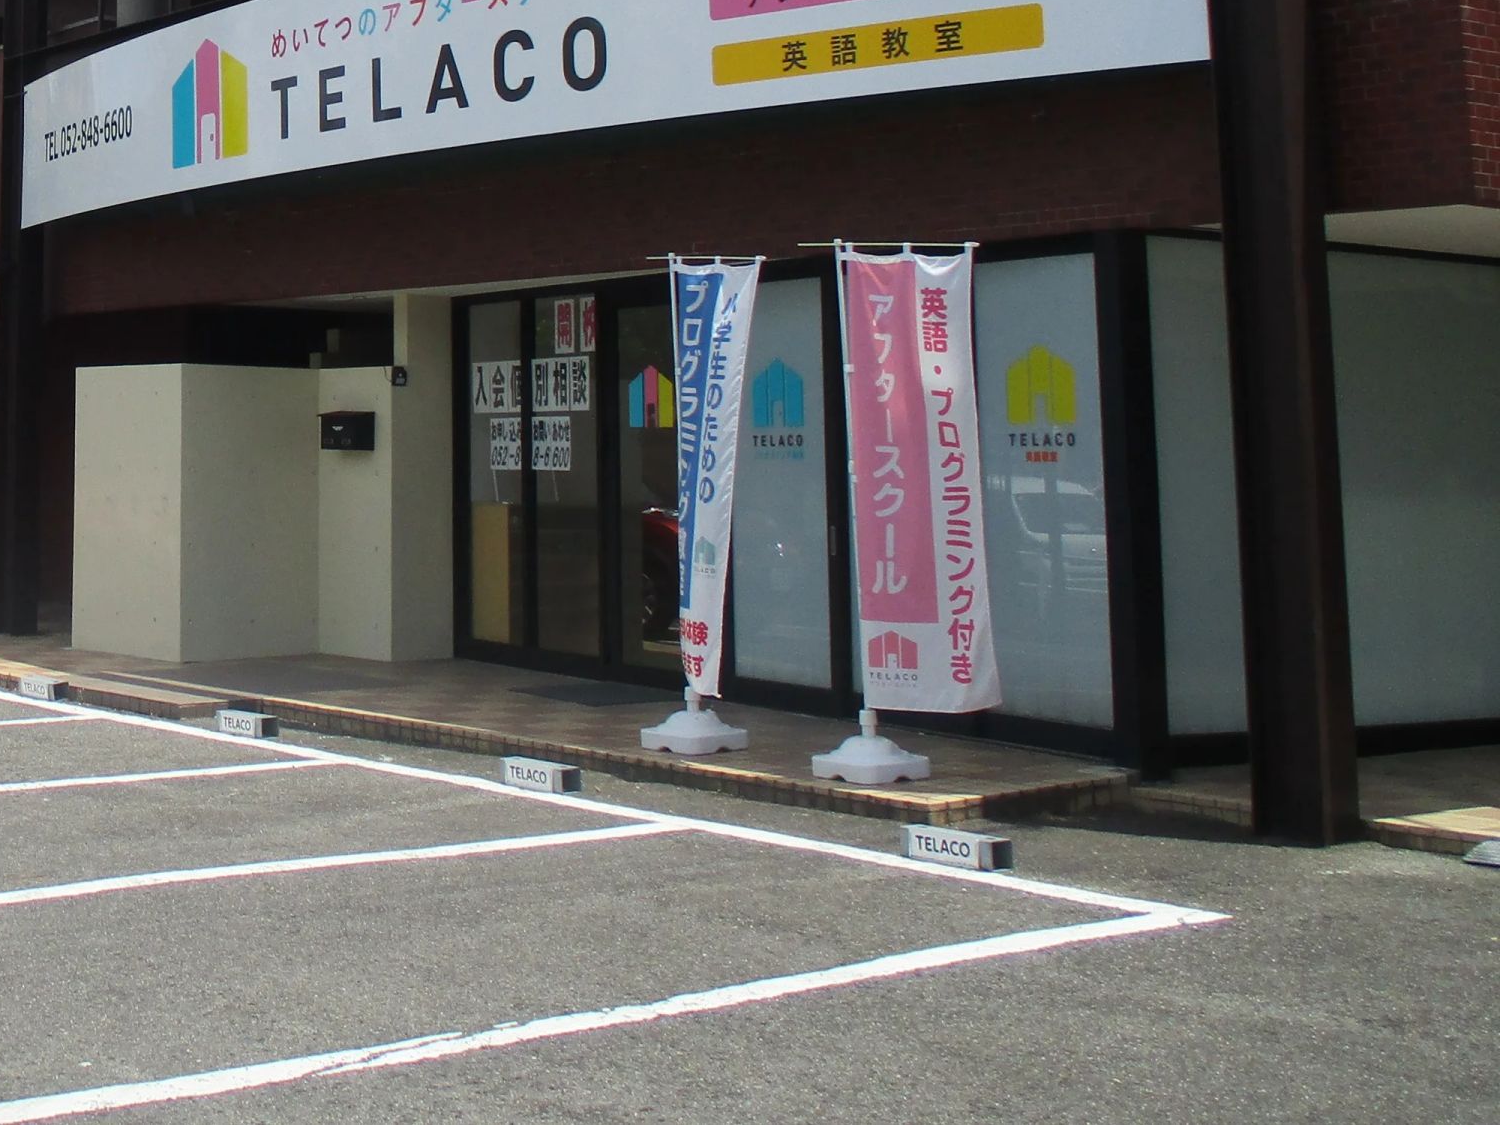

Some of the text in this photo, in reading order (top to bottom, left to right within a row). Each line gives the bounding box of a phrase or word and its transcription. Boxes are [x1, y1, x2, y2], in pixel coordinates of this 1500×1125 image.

[781, 20, 964, 72] 英語教室
[270, 15, 608, 140] TELACO
[44, 105, 133, 163] TEL 052-848-6600
[699, 292, 739, 504] 小学生のための
[752, 434, 804, 447] TELACO
[868, 294, 908, 595] アフタースクール
[1008, 433, 1076, 447] TELACO
[491, 446, 570, 468] 052-88-6600
[919, 286, 975, 685] 英語・プログラミング付き
[869, 671, 918, 682] TELACO
[23, 681, 46, 696] TELACO
[223, 715, 252, 732] TELACO
[509, 765, 547, 785] TELACO
[915, 835, 971, 858] TELACO
